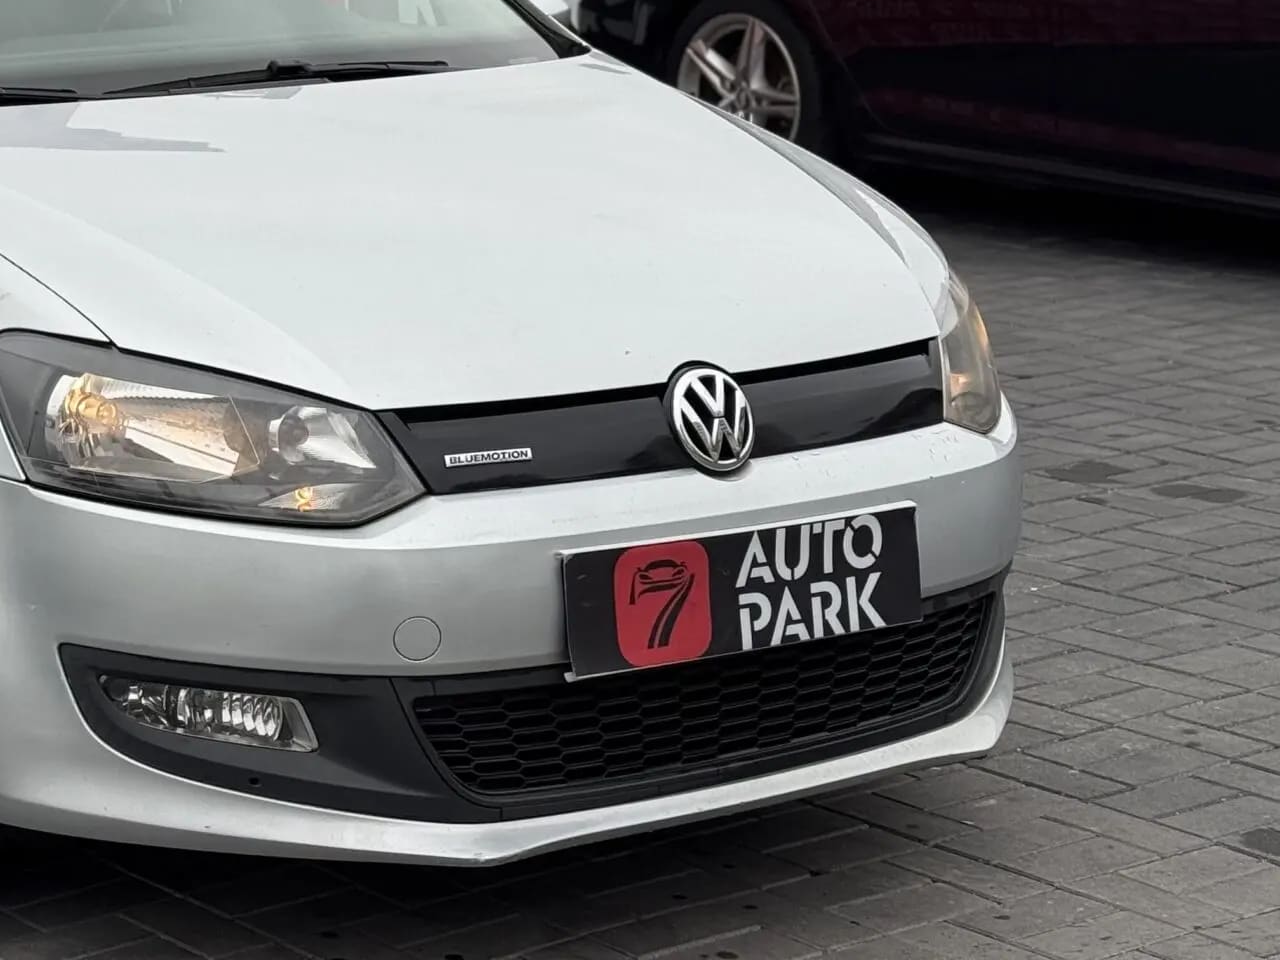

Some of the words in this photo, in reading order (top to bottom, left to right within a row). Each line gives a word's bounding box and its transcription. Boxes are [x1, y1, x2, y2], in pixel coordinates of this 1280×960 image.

[449, 450, 528, 464] BLUEMOTION
[736, 514, 883, 588] AUTO
[738, 571, 887, 651] PARK
